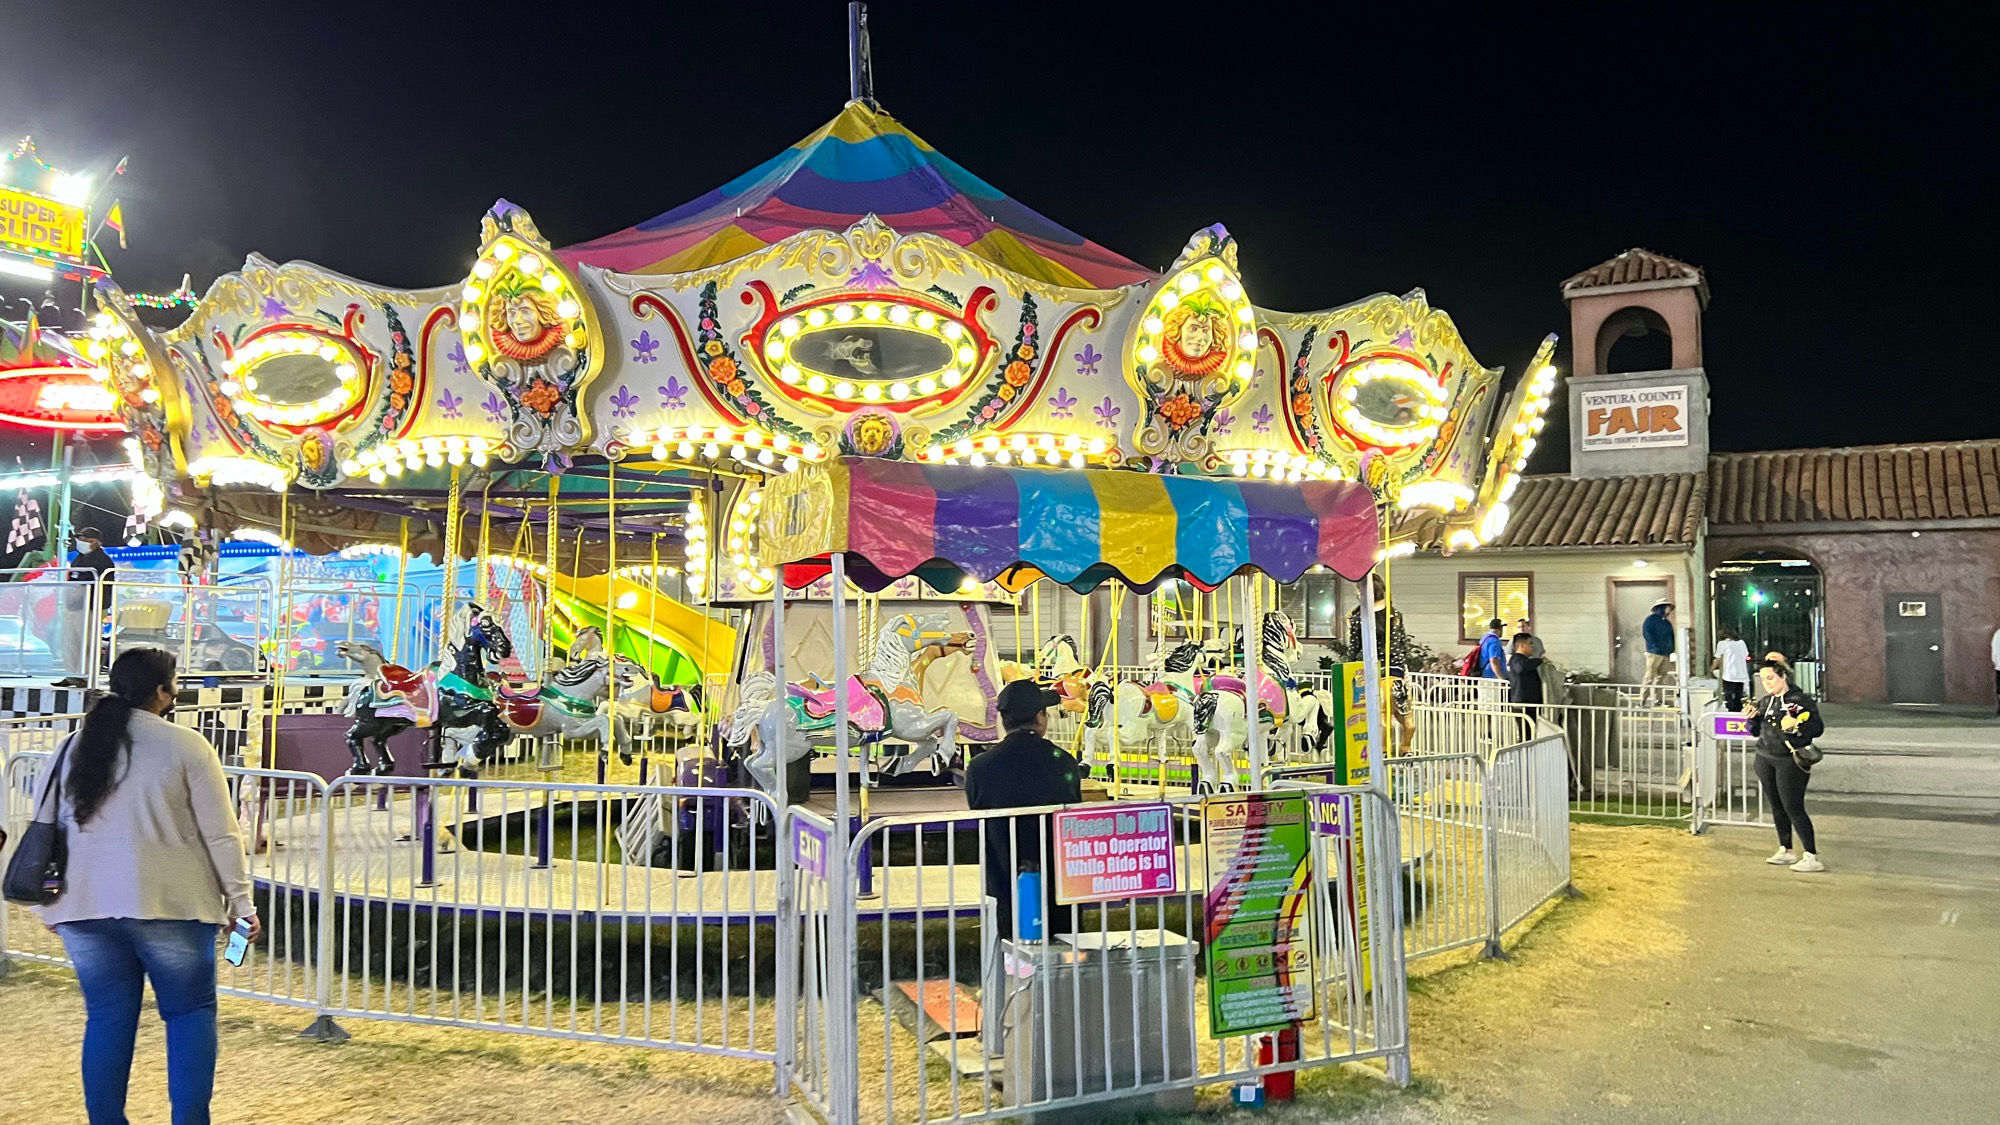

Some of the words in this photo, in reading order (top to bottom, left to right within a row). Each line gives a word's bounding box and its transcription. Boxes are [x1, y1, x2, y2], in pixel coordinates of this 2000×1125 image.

[0, 198, 55, 222] SUPER
[1585, 393, 1636, 406] VENTURA
[1638, 390, 1684, 403] COUNTY
[1587, 404, 1683, 437] FAIR
[1726, 720, 1748, 732] EX
[1225, 801, 1285, 817] SAFETY
[1062, 817, 1114, 839] Please
[1116, 813, 1136, 835] Do
[1138, 810, 1166, 833] NOT
[799, 830, 821, 865] EXIT
[1064, 840, 1092, 858] Talk
[1093, 840, 1107, 856] to
[1109, 836, 1167, 856] Operator
[1065, 859, 1105, 877] While
[1107, 855, 1137, 873] Ride
[1092, 872, 1142, 894] Motion!
